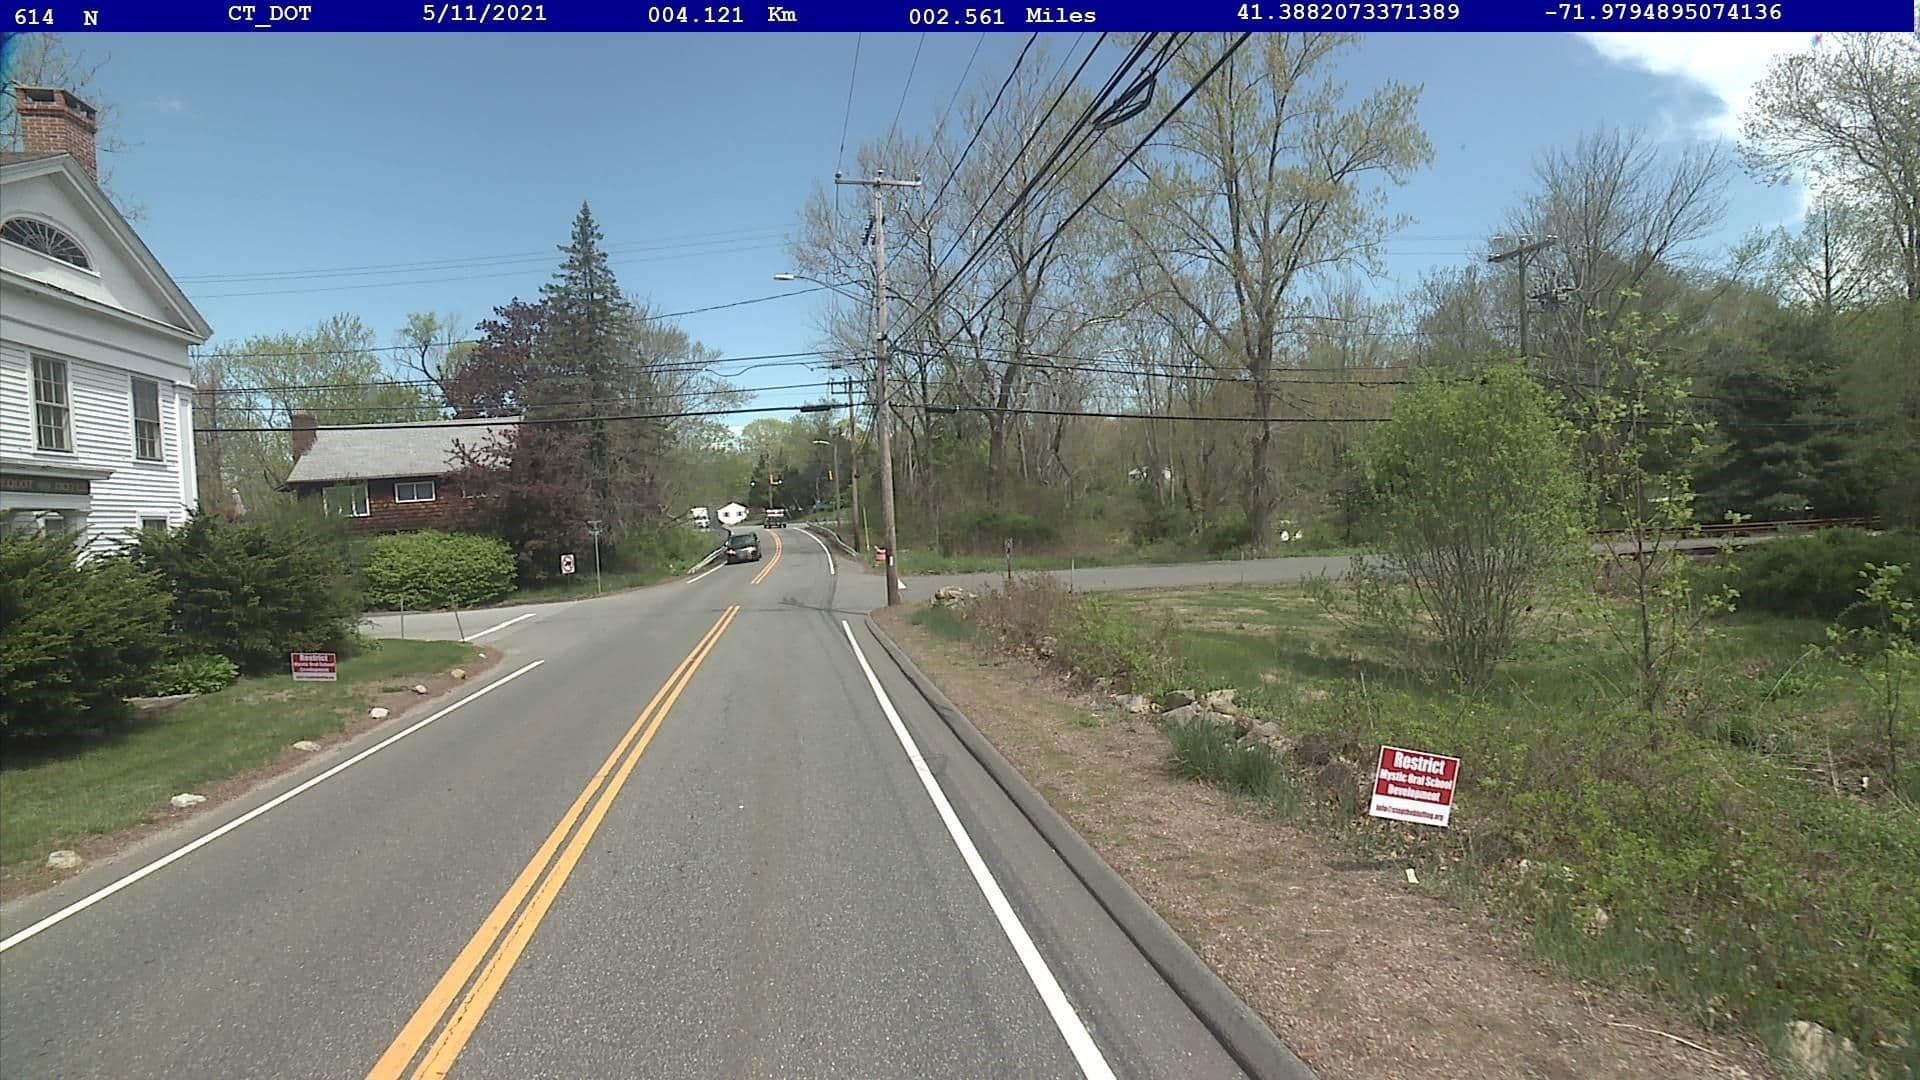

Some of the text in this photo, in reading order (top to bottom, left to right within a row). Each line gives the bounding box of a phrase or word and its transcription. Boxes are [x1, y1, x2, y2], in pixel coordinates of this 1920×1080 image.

[1393, 751, 1446, 775] Restrict
[1380, 768, 1453, 790] Mystic Oral School
[1387, 783, 1441, 802] Development
